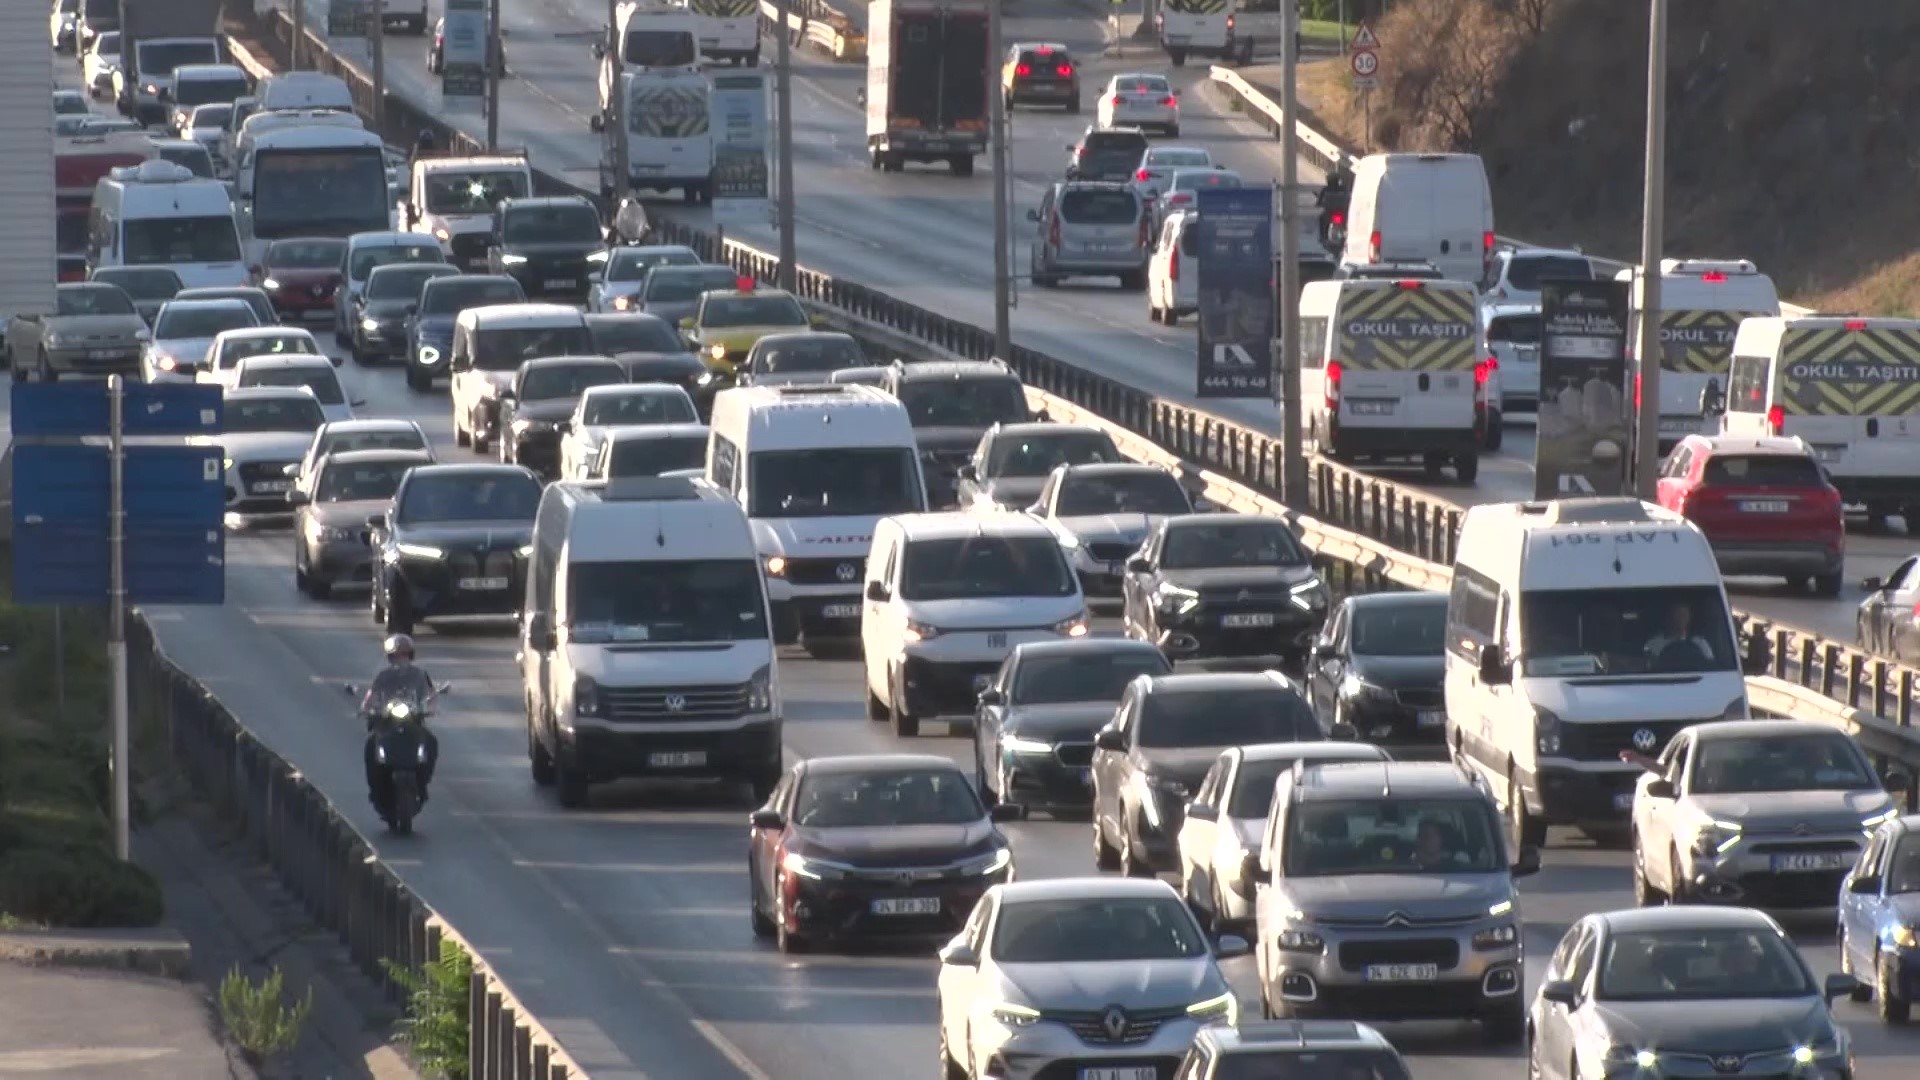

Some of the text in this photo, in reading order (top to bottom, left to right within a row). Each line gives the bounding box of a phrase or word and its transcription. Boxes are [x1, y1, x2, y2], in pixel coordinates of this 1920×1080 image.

[1349, 322, 1401, 335] OKUL
[1660, 328, 1709, 342] OKUL
[1792, 364, 1850, 378] OKUL
[817, 534, 873, 545] ALTU
[1551, 531, 1680, 547] LAP 561
